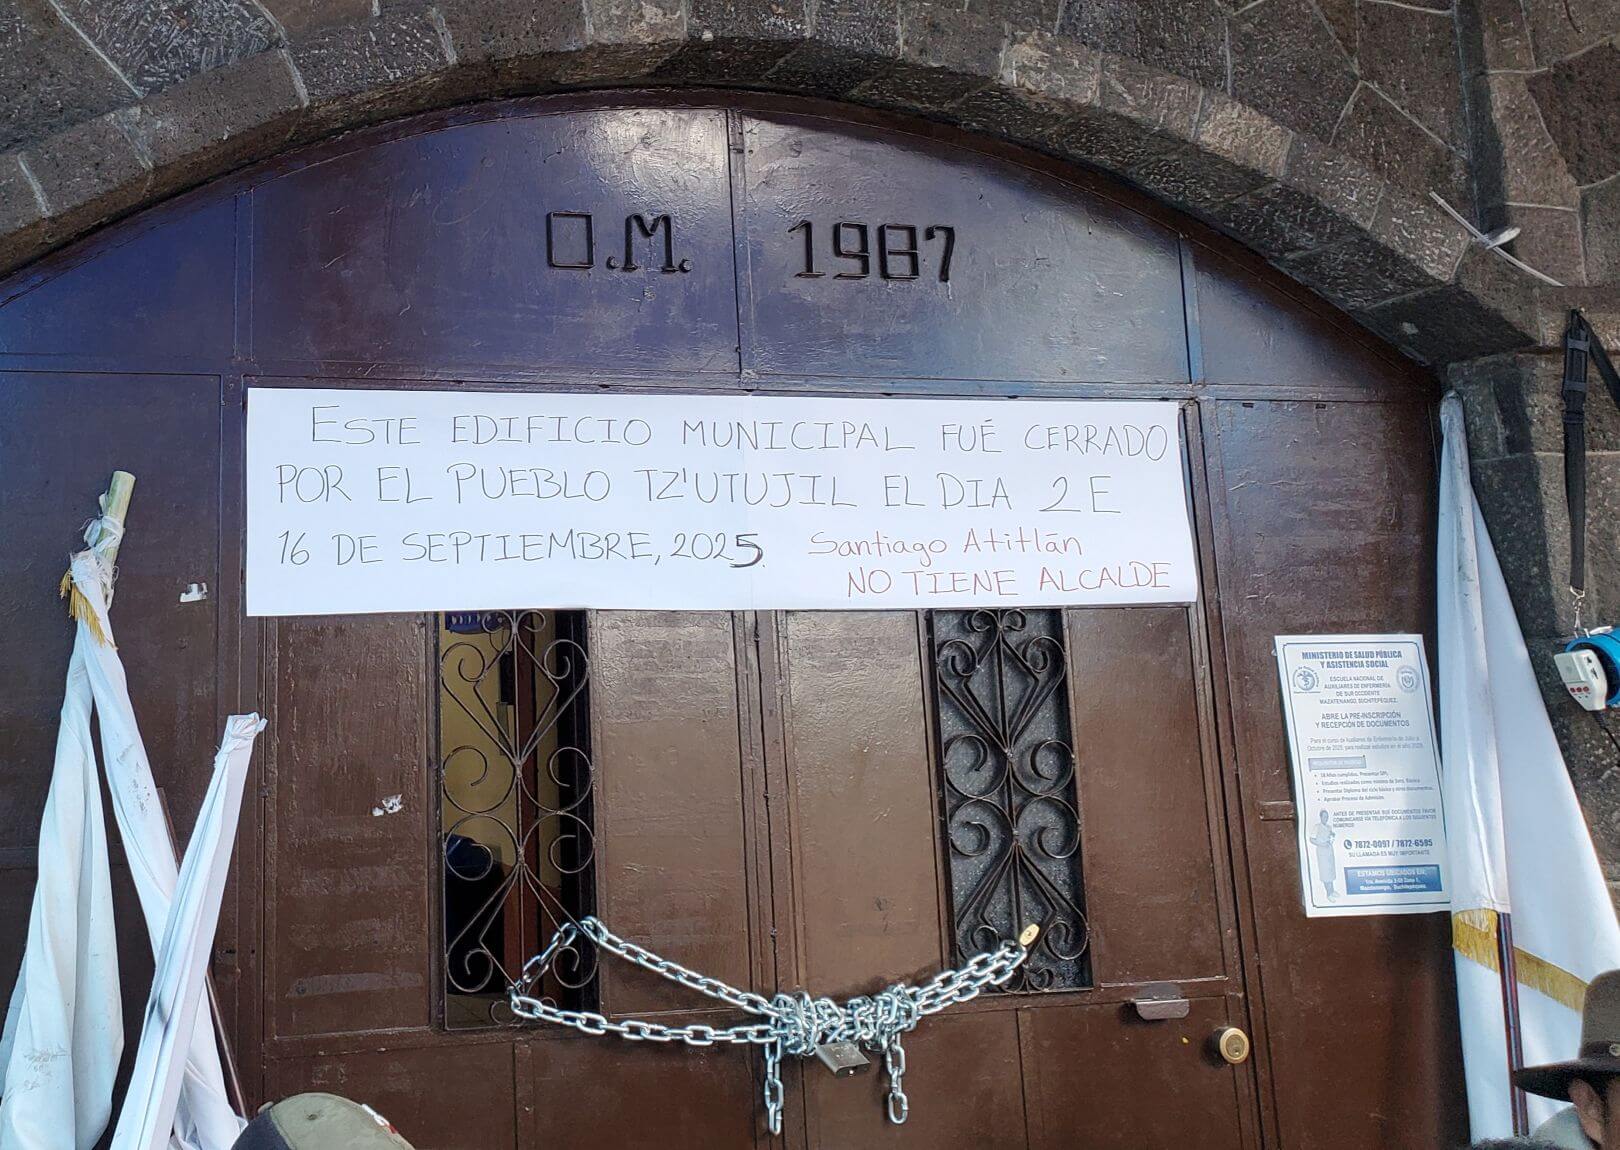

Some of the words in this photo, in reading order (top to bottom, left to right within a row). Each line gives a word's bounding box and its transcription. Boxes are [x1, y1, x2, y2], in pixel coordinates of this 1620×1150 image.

[788, 219, 956, 283] 1987
[311, 405, 421, 445] ESTE
[451, 415, 652, 446] EDIFICIO
[682, 419, 915, 451] MUNICIPAL
[942, 418, 1002, 454] FUÉ
[1024, 423, 1168, 461] CERRADO
[276, 463, 352, 504] POR
[377, 466, 433, 503] EL
[446, 462, 611, 504] PUEBLO
[634, 468, 857, 508] TZ'UTUJIL
[884, 474, 926, 508] EL
[937, 472, 1013, 511] DIA
[278, 530, 311, 566] 16
[332, 533, 384, 567] DE
[402, 528, 661, 566] SEPTIEMBRE,
[808, 530, 948, 567] Santiago
[963, 527, 1083, 556] Atitlán
[847, 566, 892, 598] NO
[901, 569, 1019, 597] TIENE
[1039, 561, 1172, 593] ALCALDE
[1302, 652, 1344, 660] MINISTERIO
[1345, 651, 1353, 659] DE
[1353, 651, 1375, 659] SALUD
[1320, 660, 1326, 669] Y
[1326, 660, 1364, 669] ASISTENCIA
[1366, 660, 1389, 668] SOCIAL
